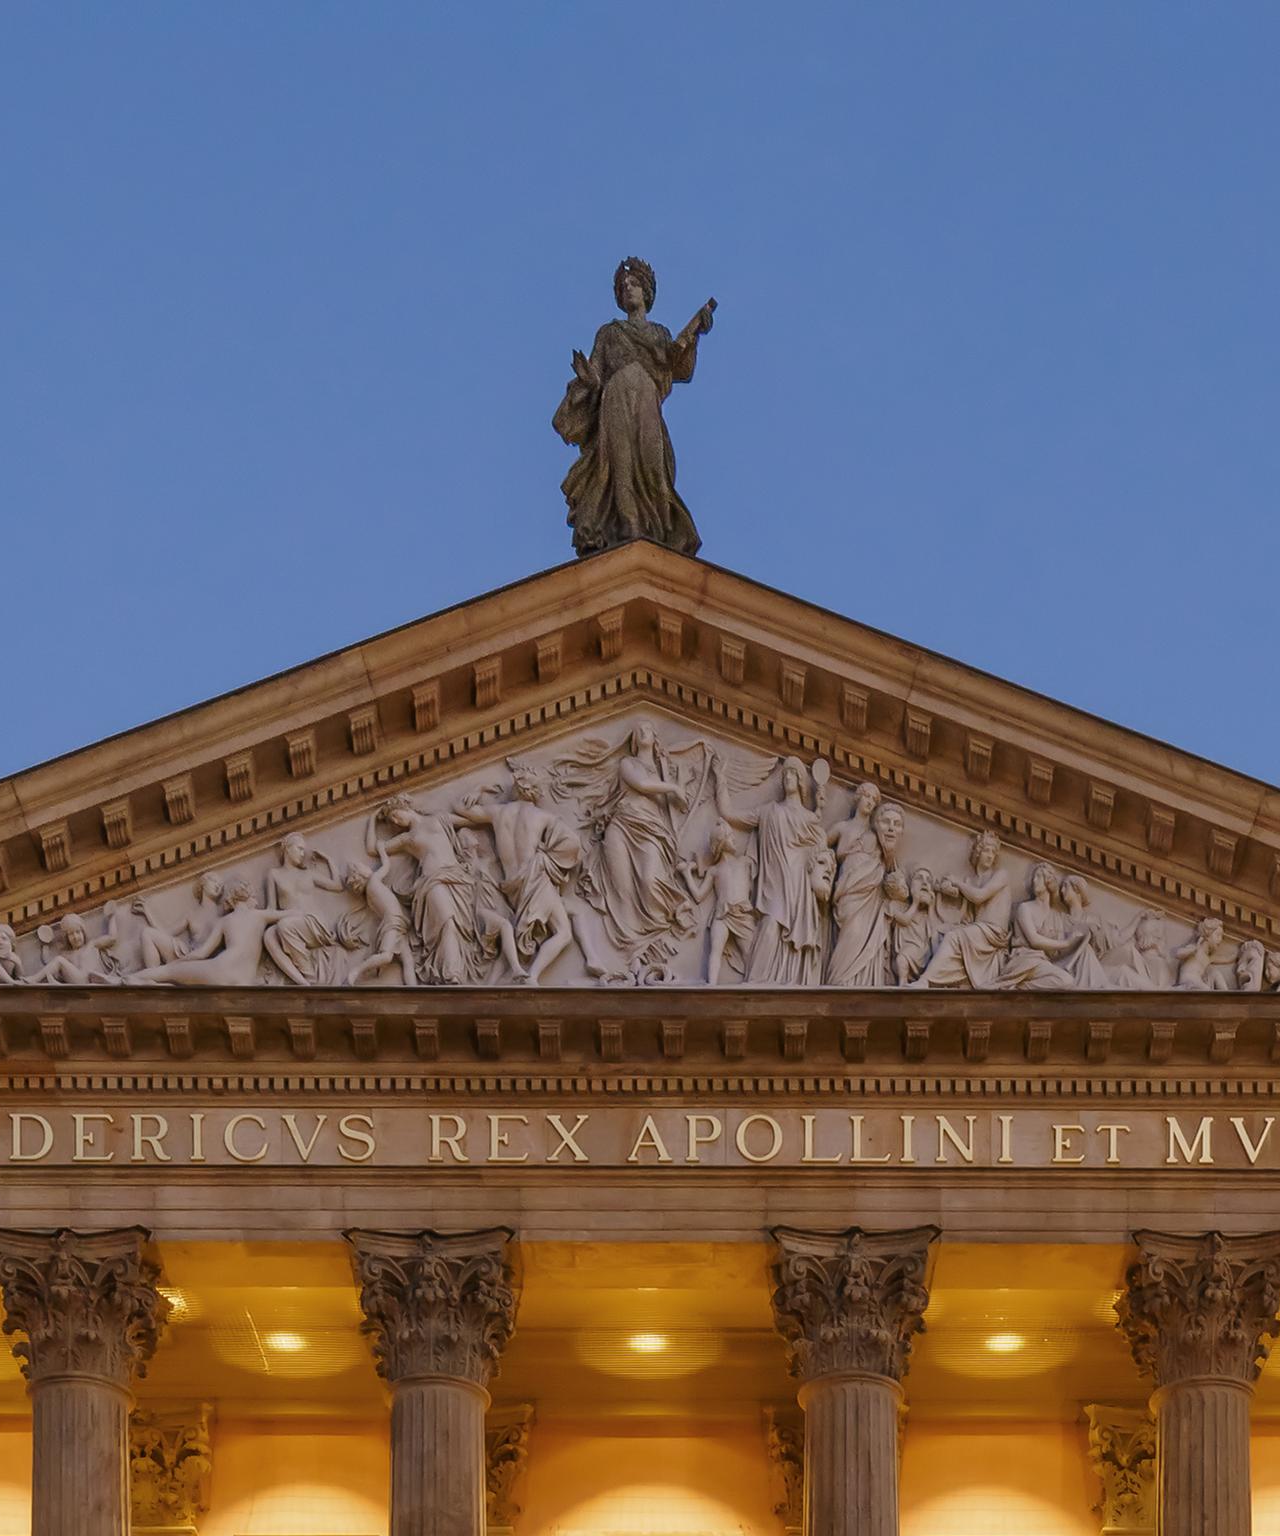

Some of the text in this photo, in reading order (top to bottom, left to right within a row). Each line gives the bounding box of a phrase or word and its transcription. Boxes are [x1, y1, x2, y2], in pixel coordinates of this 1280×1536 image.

[428, 1113, 590, 1163] REX
[627, 1114, 1014, 1165] APOLLINI
[1050, 1124, 1131, 1164] ET
